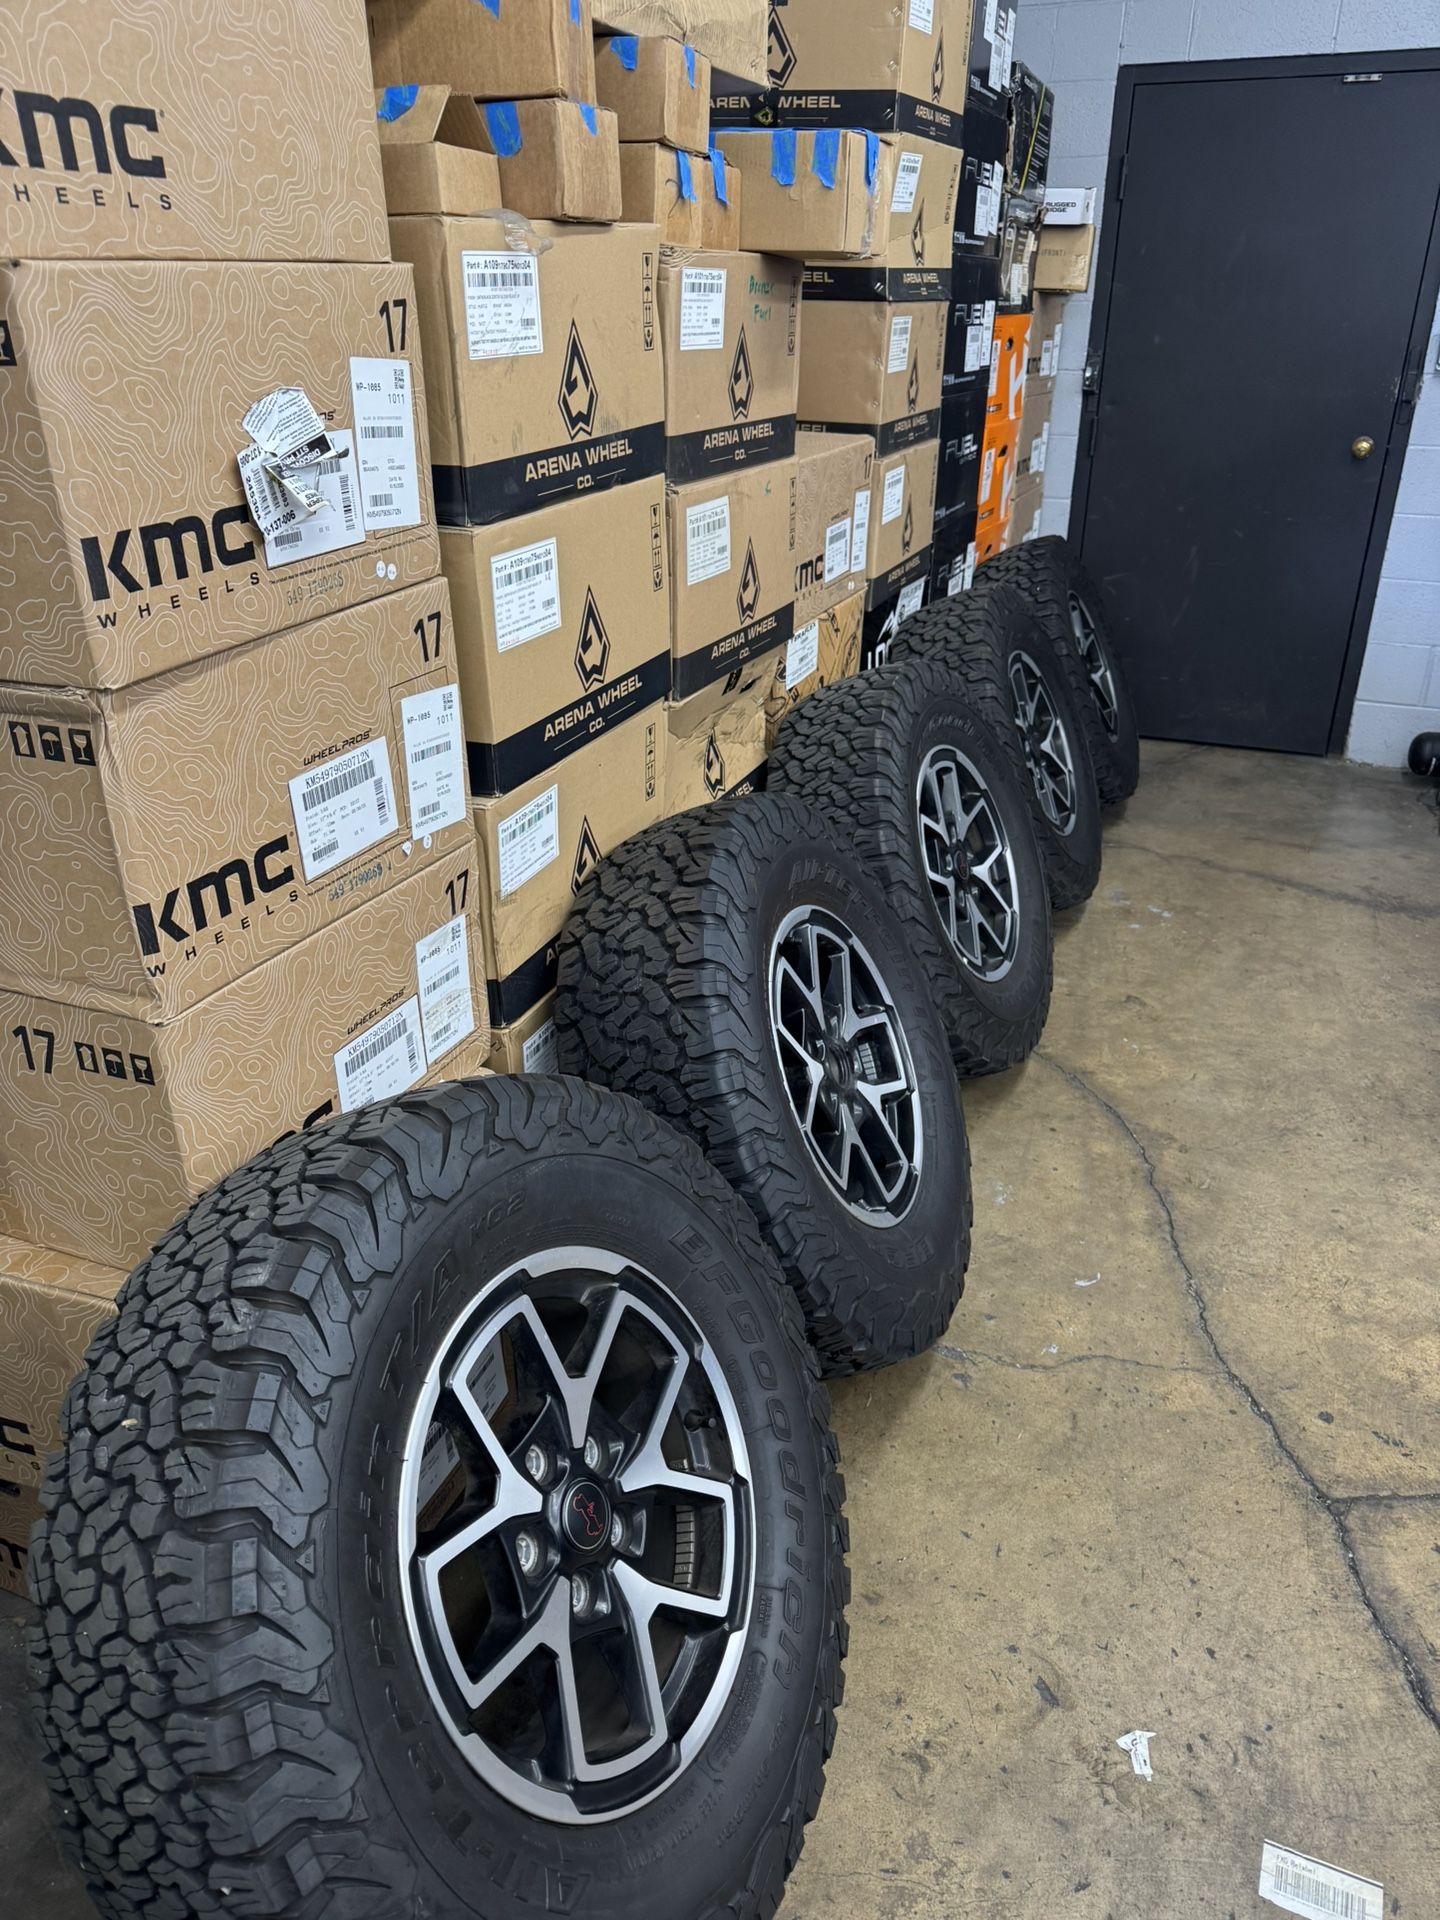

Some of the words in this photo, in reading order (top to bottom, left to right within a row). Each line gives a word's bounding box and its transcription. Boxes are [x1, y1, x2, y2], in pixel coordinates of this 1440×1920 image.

[379, 298, 407, 353] 17
[388, 394, 406, 405] 1011
[524, 456, 582, 483] ARENA
[585, 438, 633, 467] WHEEL
[703, 429, 740, 450] ARENA
[741, 423, 775, 443] WHEEL
[576, 474, 595, 490] CO.
[81, 504, 256, 602] KMC
[97, 572, 260, 630] WHEELS
[413, 611, 442, 662] 17
[711, 633, 745, 660] ARENA
[746, 615, 777, 642] WHEEL
[437, 713, 453, 726] 1011
[543, 705, 595, 742] ARENA
[597, 674, 643, 710] WHEEL
[588, 719, 606, 732] CO.
[132, 834, 296, 957] KMC
[445, 868, 470, 916] 17
[146, 888, 300, 978] WHEELS
[12, 1025, 57, 1074] 17
